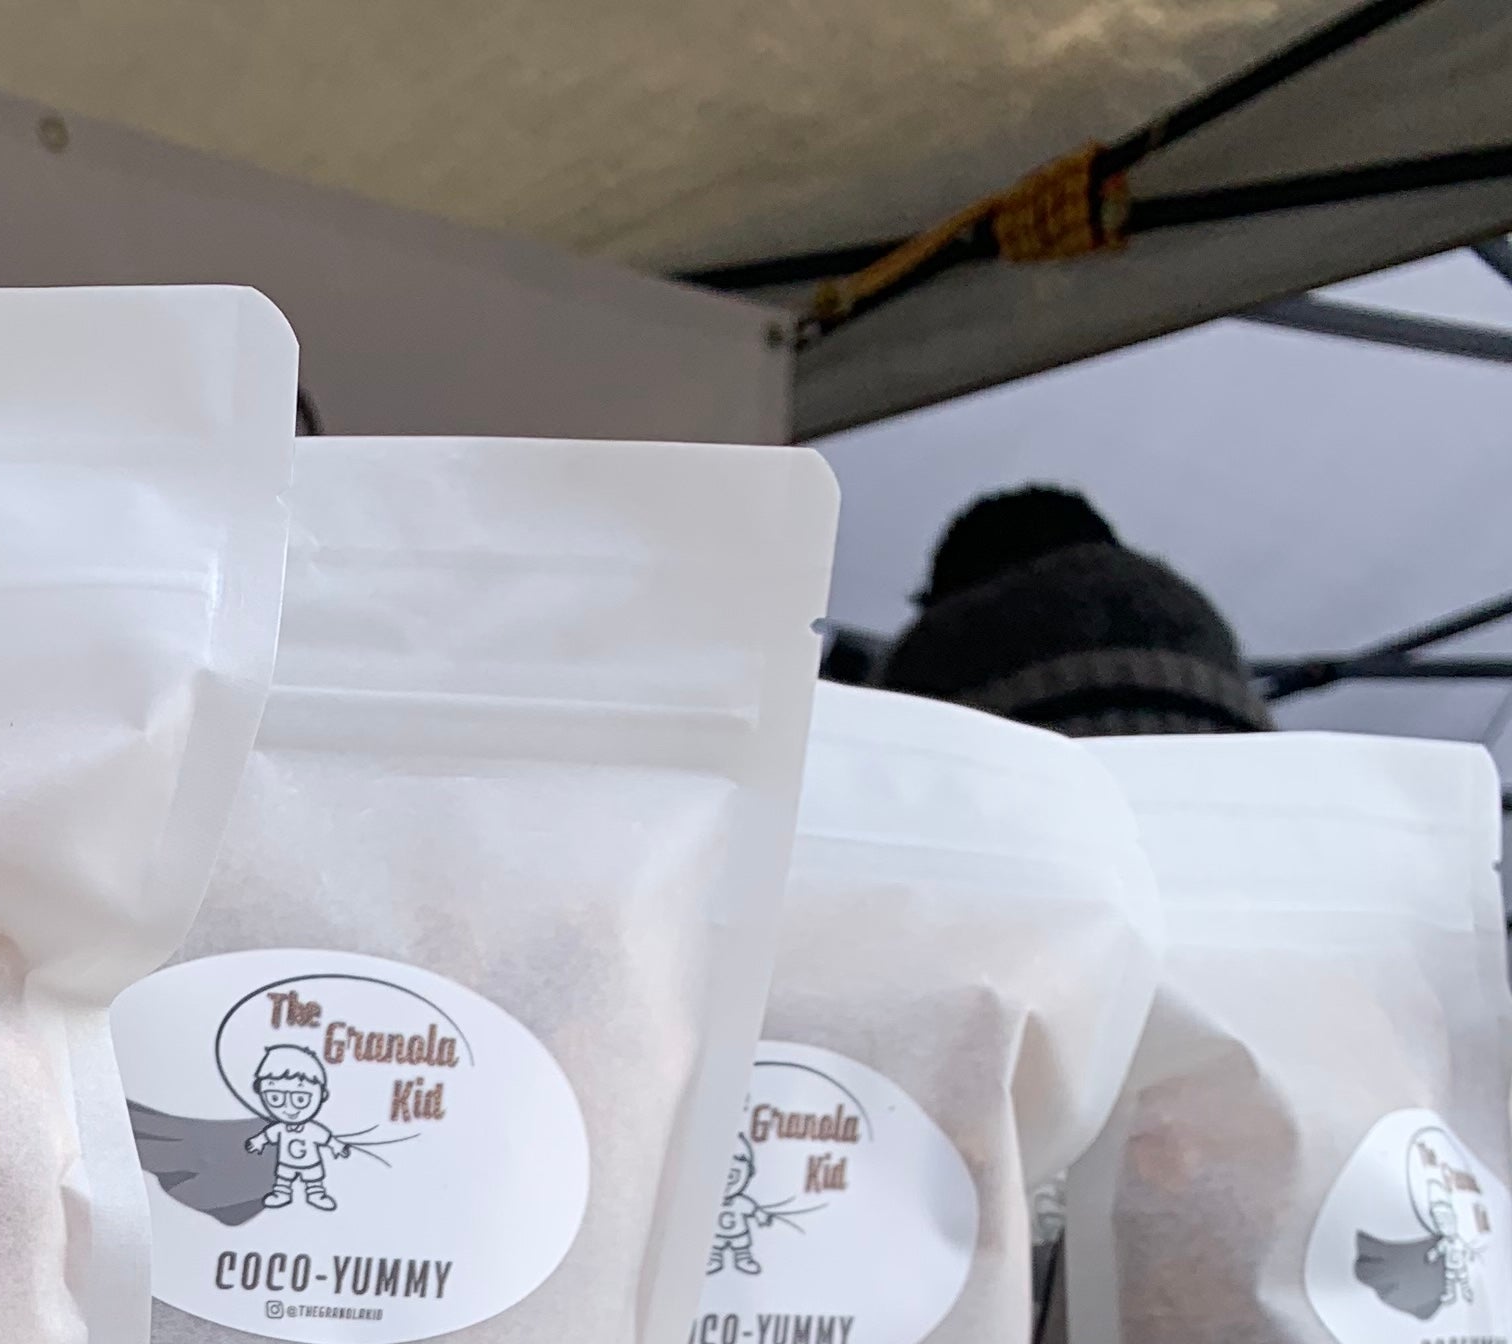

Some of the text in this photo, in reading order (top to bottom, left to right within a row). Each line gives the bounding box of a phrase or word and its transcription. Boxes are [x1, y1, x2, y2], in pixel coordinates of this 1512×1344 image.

[267, 990, 322, 1030] The
[323, 1021, 459, 1068] Granola
[390, 1077, 445, 1122] Kid
[750, 1103, 862, 1144] Granola
[287, 1138, 309, 1160] G
[804, 1152, 848, 1194] Kid
[717, 1210, 737, 1231] G
[214, 1250, 454, 1300] COCO-YUMMY
